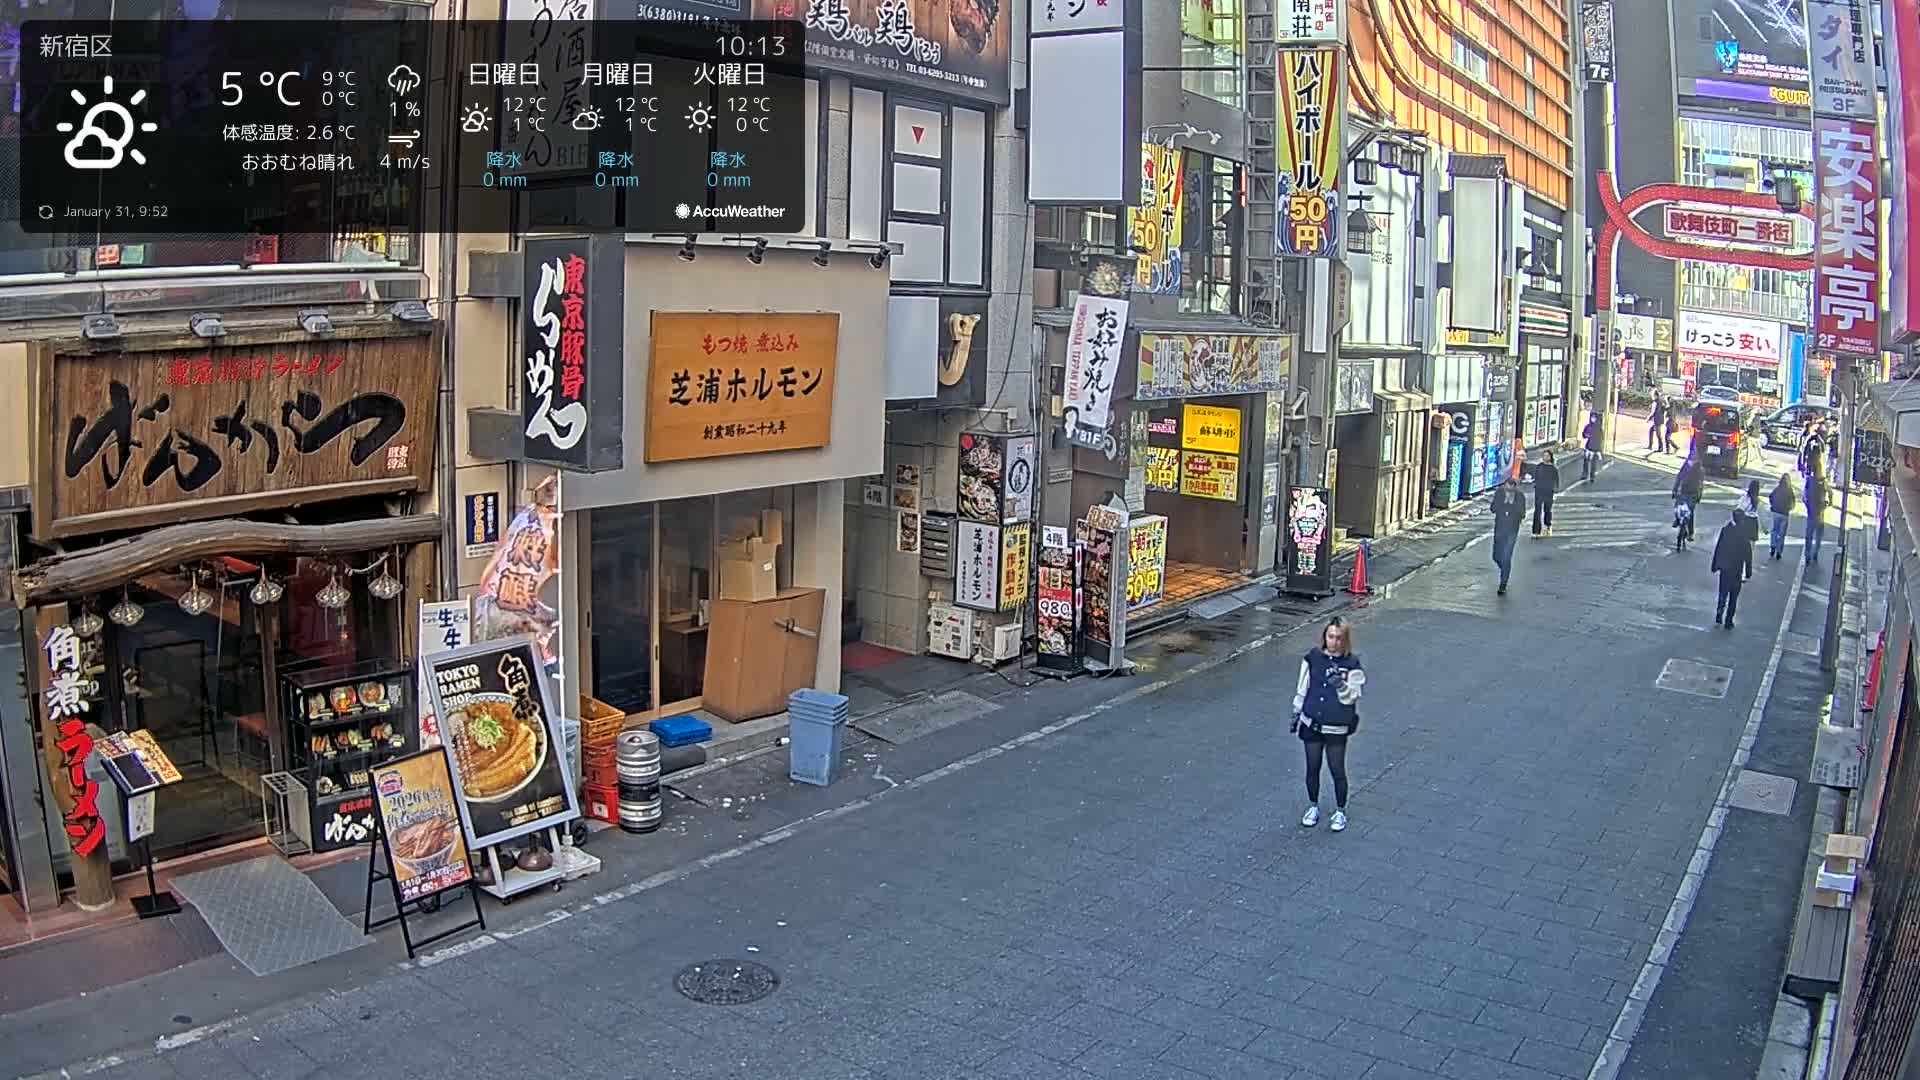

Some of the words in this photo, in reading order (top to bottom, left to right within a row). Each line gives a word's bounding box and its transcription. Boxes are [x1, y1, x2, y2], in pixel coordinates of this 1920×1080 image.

[1589, 64, 1610, 79] 7F
[1832, 98, 1856, 113] 3F
[1296, 54, 1321, 191] ハイボール
[1161, 151, 1175, 289] ハイボール
[1669, 211, 1791, 243] 歌舞伎町一番街
[1820, 127, 1876, 330] 安楽亭
[561, 254, 586, 401] 東京豚骨
[1686, 329, 1735, 349] けっこう
[1818, 333, 1837, 347] 2F
[668, 366, 823, 405] 芝浦ホルモン
[1046, 532, 1063, 546] 4階
[1005, 552, 1017, 599] 作動中
[1040, 600, 1070, 617] 980
[437, 663, 479, 684] TOKYO
[440, 678, 481, 698] RAMEN
[443, 694, 472, 710] SHOP
